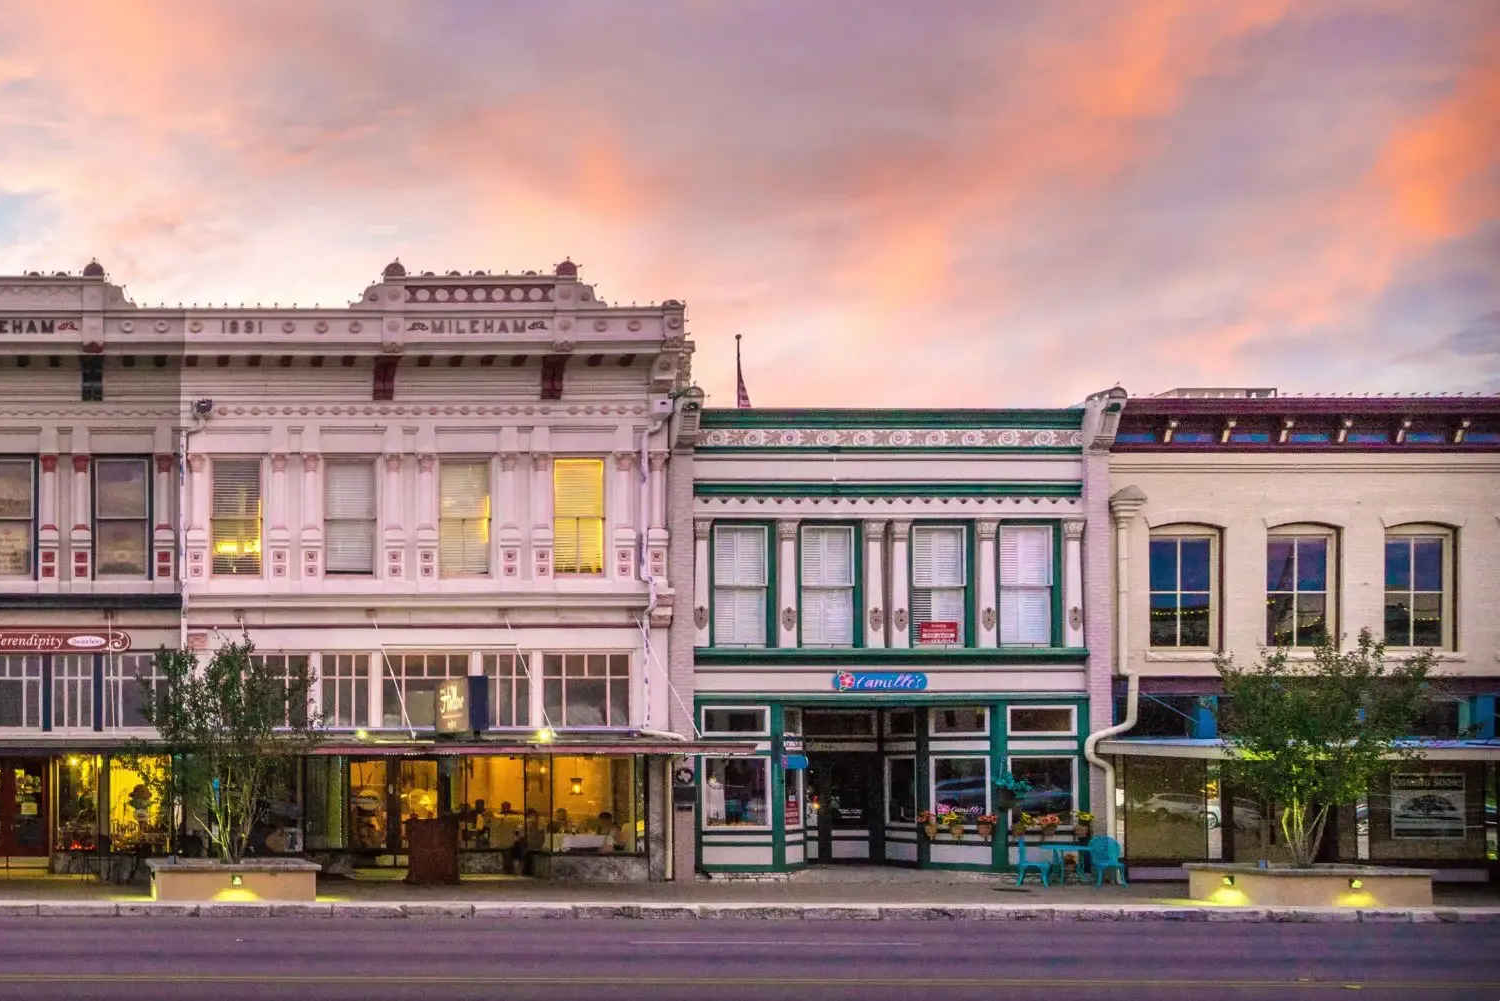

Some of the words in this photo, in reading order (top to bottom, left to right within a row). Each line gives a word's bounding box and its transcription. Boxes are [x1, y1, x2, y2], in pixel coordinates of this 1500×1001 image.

[221, 320, 263, 334] 1891
[430, 320, 527, 334] MILEHAM
[857, 673, 922, 689] Camille's
